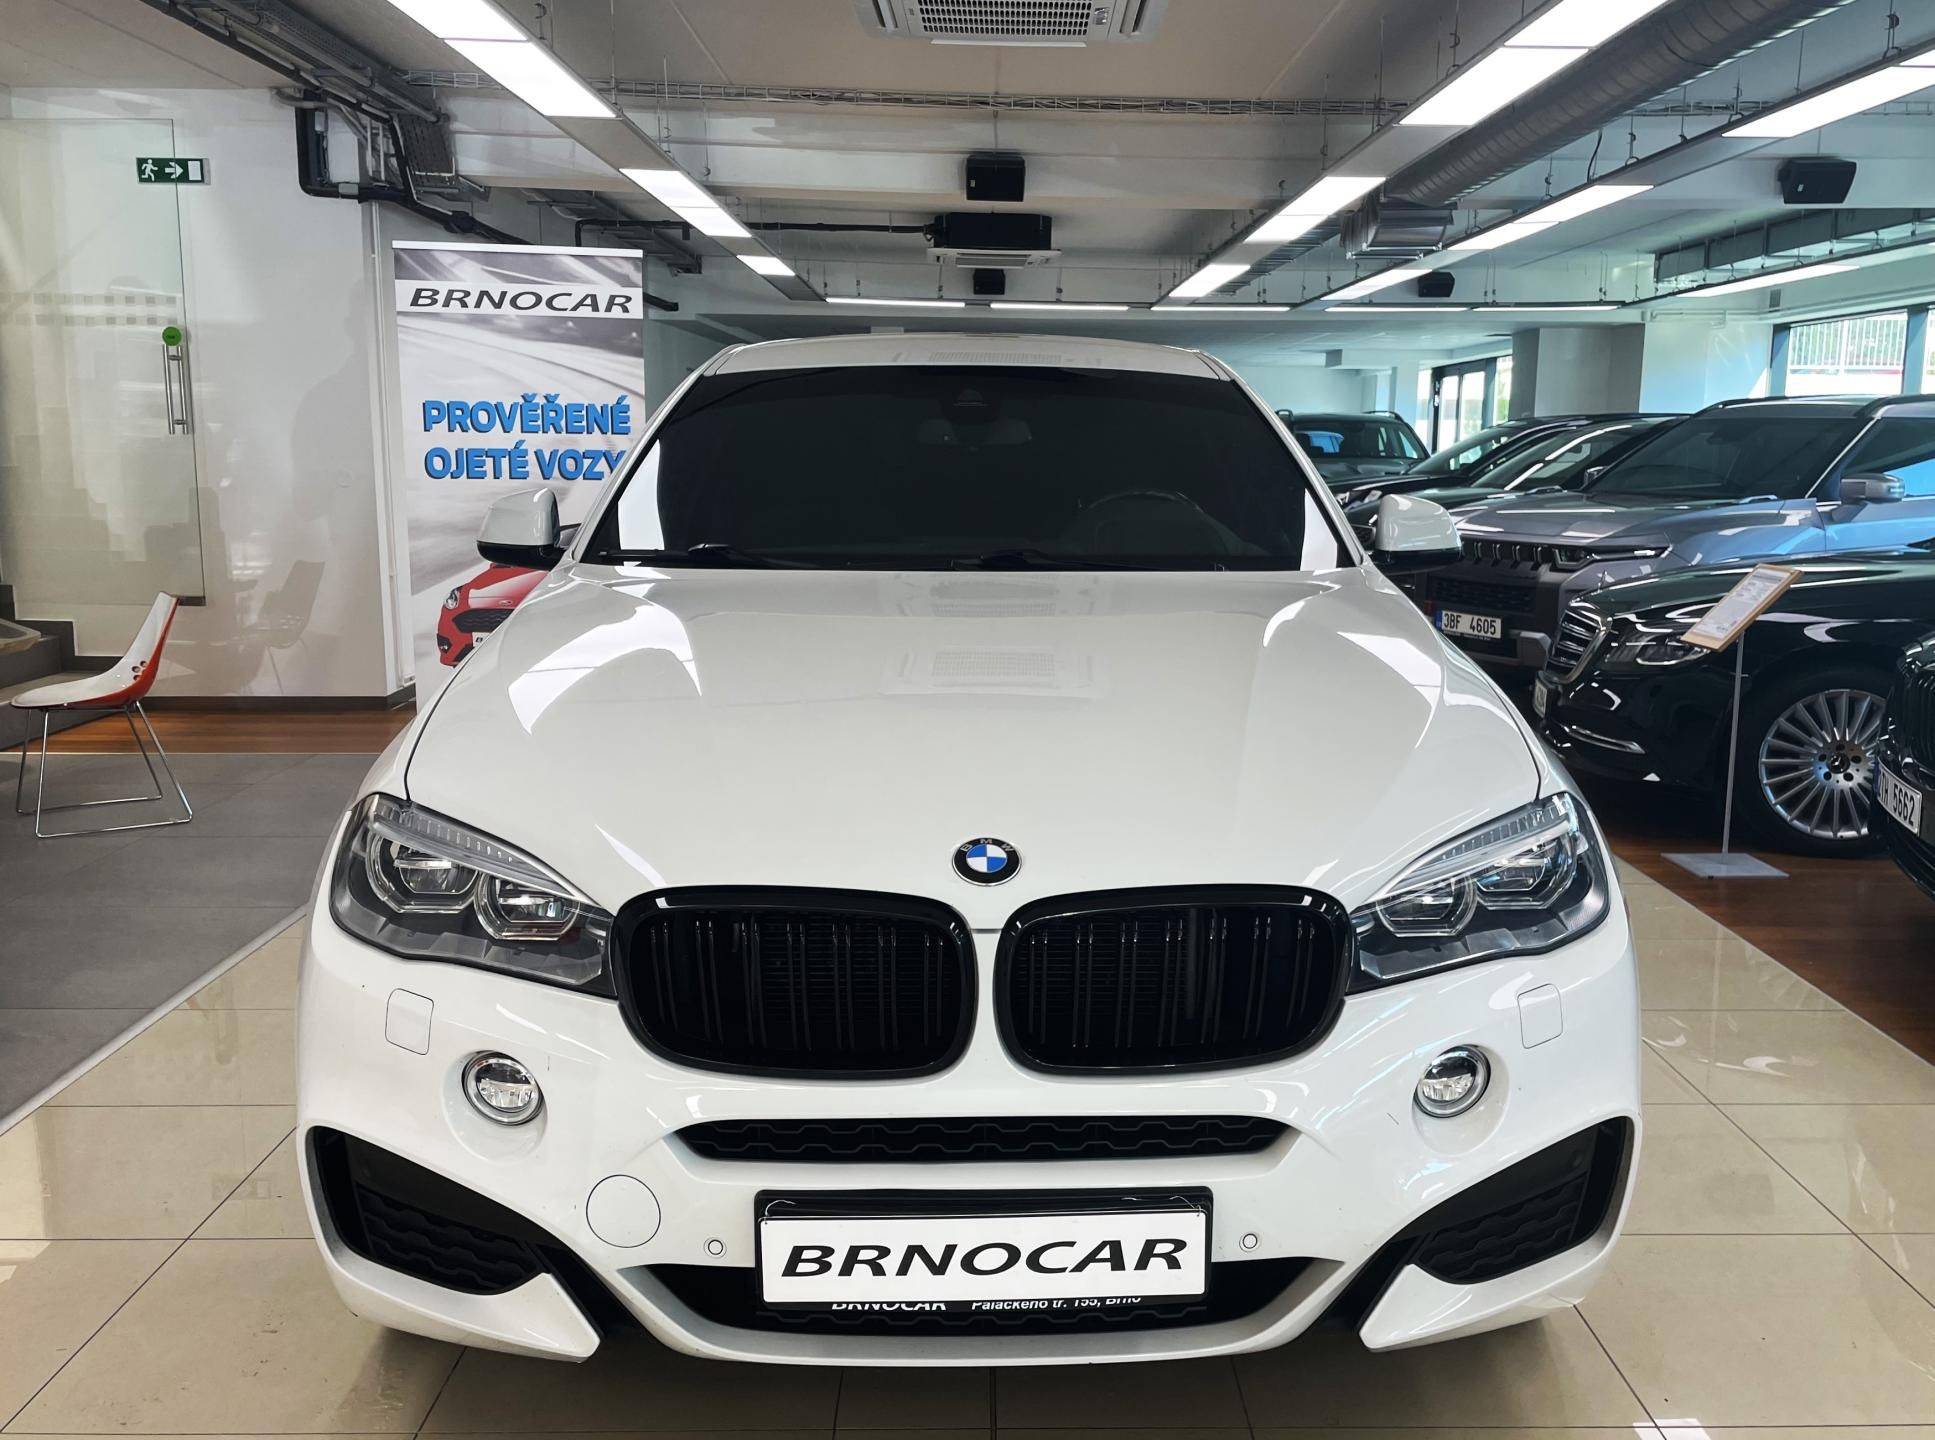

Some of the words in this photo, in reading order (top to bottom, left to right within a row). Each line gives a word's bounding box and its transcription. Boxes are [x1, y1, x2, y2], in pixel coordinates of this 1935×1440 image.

[409, 287, 633, 314] BRNOCAR
[422, 393, 632, 434] PROVĚŘENÉ
[424, 439, 530, 480] OJETÉ
[533, 448, 627, 480] VOZY
[1443, 613, 1461, 629] 3BF
[1470, 616, 1496, 635] 4605
[1893, 783, 1915, 826] 5662
[960, 838, 1015, 851] BMW
[781, 1238, 1188, 1277] BRNOCAR
